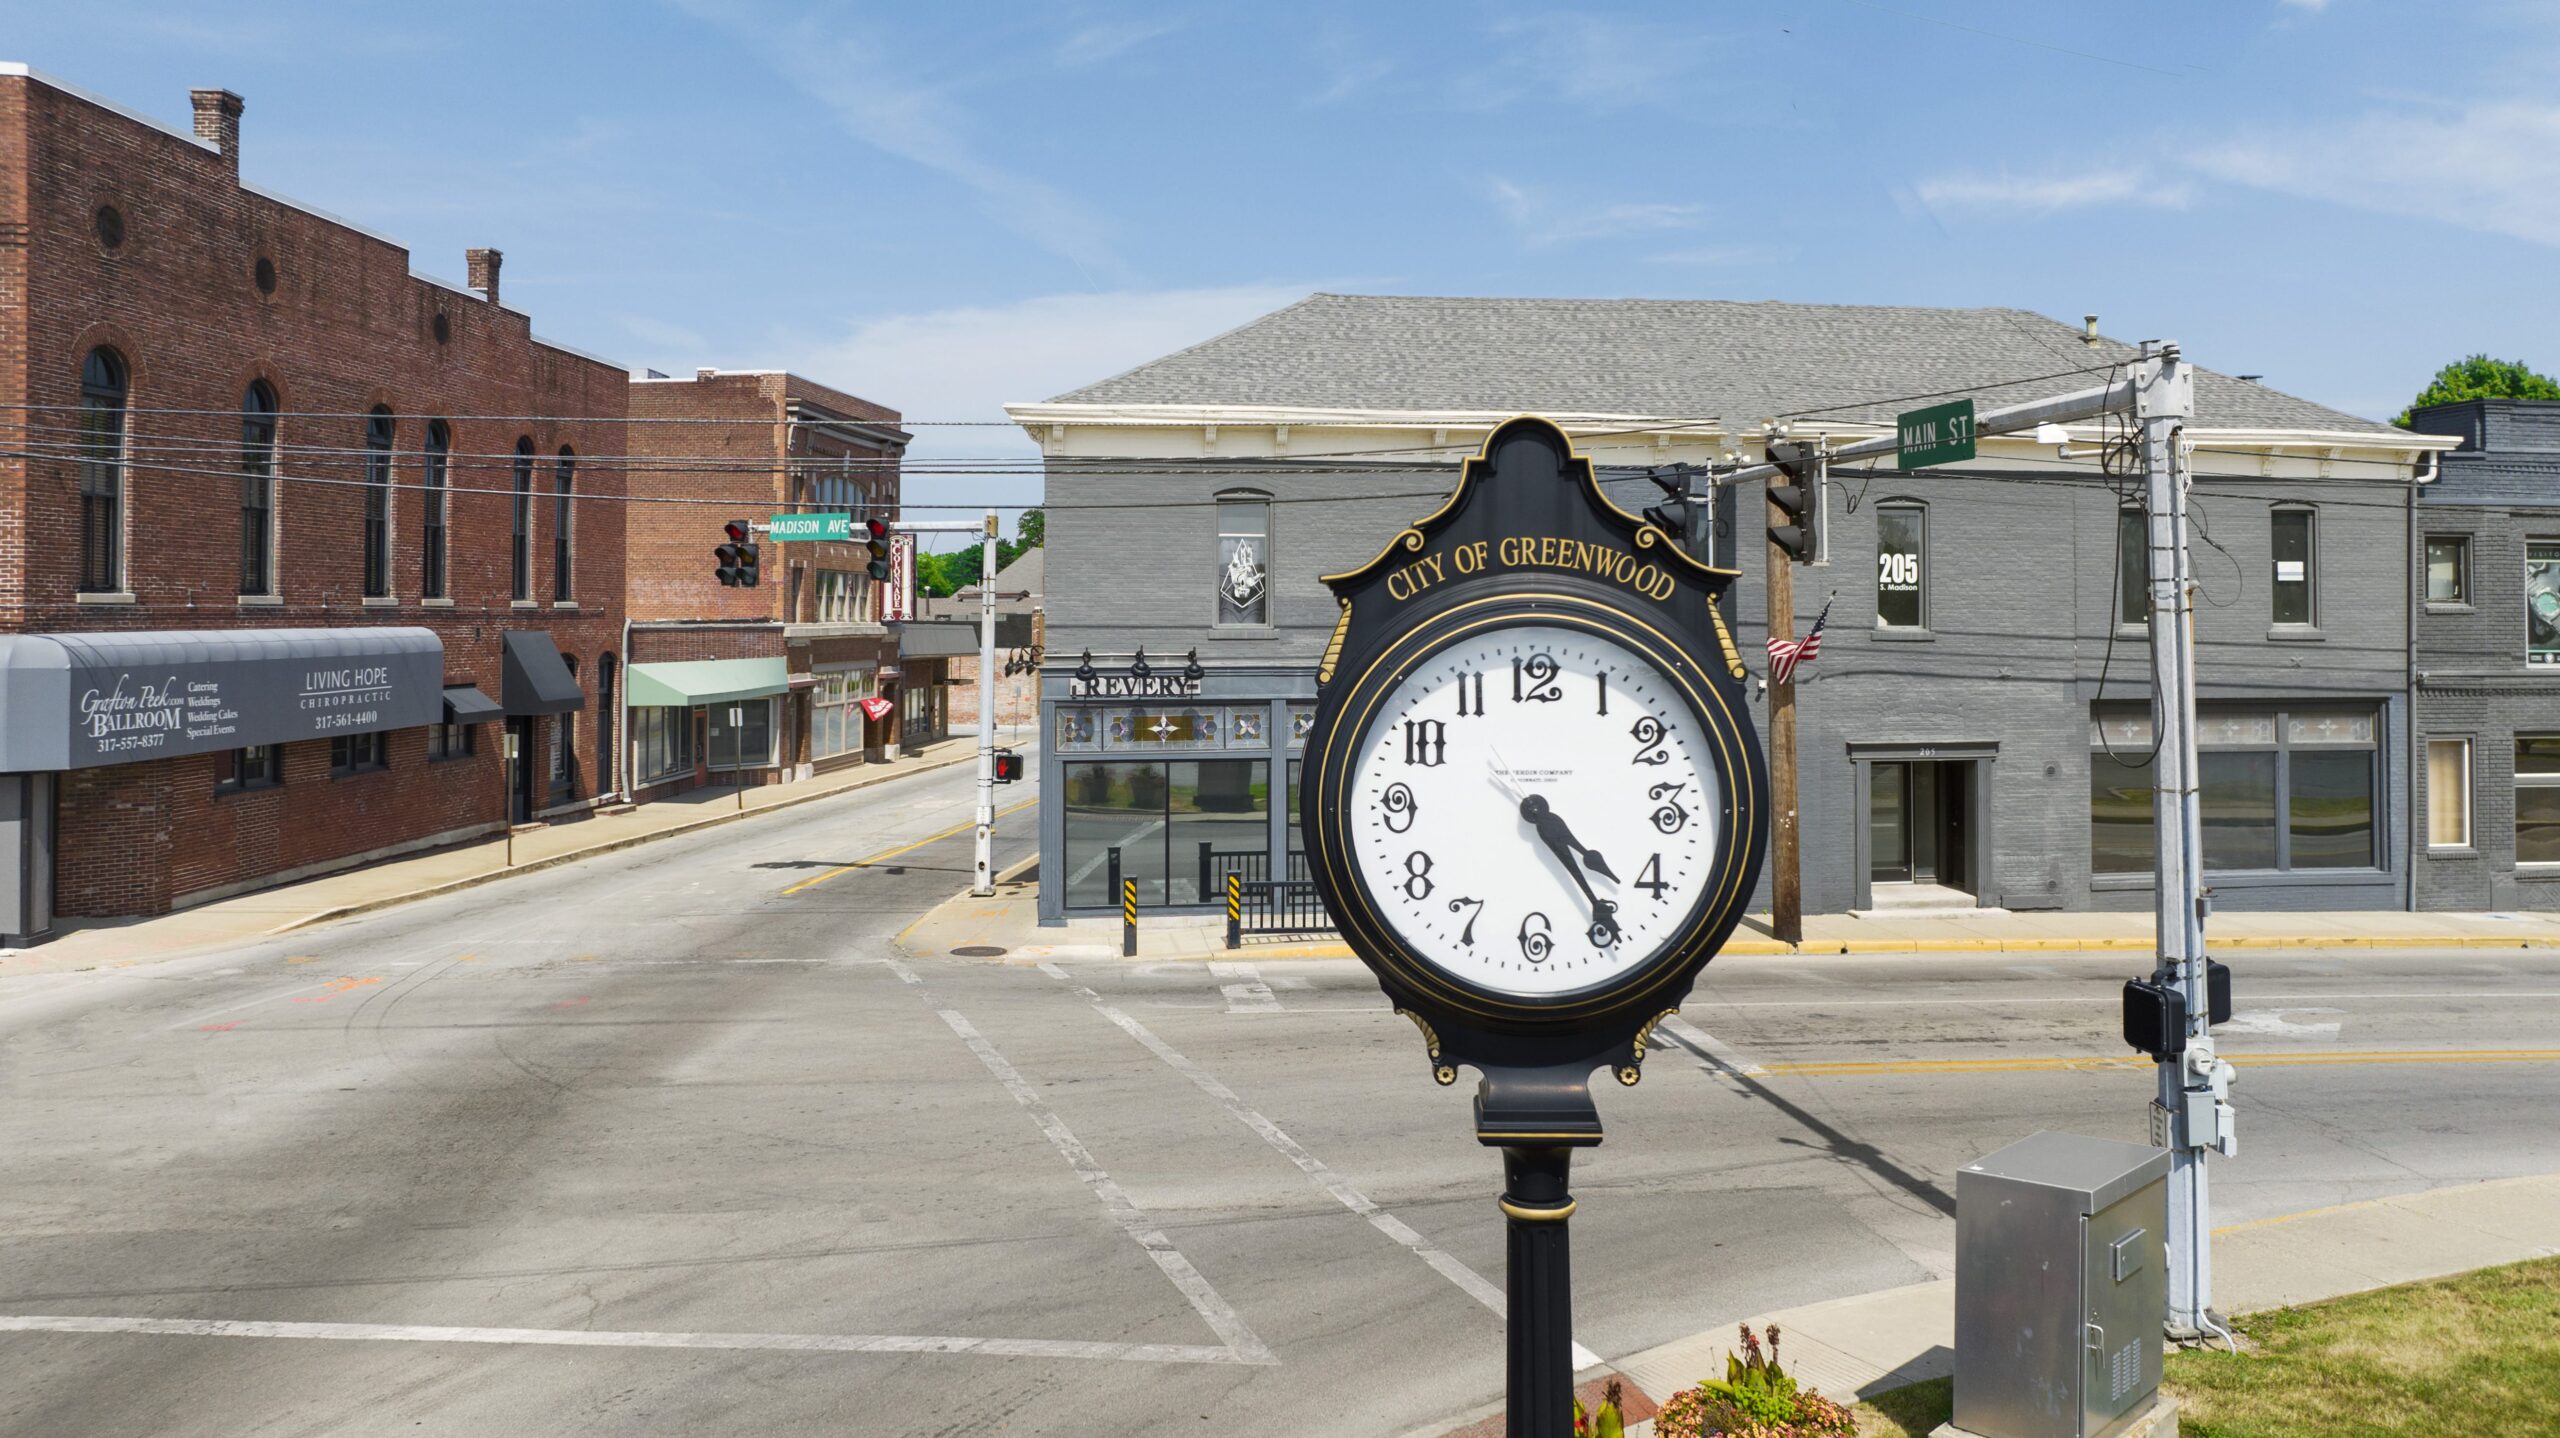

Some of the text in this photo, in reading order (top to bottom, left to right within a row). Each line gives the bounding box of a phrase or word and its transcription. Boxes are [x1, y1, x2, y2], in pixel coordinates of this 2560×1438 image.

[1904, 415, 1968, 454] MAIN ST
[770, 520, 849, 534] MADISON AVE
[892, 546, 901, 608] COLONNADE
[1387, 537, 1675, 601] CITY OF GREENWOOD
[1879, 553, 1918, 584] 205
[187, 681, 218, 693] Catering
[306, 667, 387, 690] LIVING HOPE
[1085, 677, 1187, 697] REVERY
[1456, 671, 1486, 717] 11
[1512, 653, 1563, 704] 12
[1596, 670, 1609, 716] 1
[187, 695, 221, 708] Weddings
[187, 709, 238, 722] Wedding Cakes
[300, 691, 391, 709] CHIROPRACTIC
[315, 710, 378, 729] 317-561-4400
[88, 708, 182, 737] BALLROOM
[98, 733, 164, 752] 317-557-8377
[186, 724, 236, 740] Special Events
[1404, 719, 1447, 767] 10
[1629, 716, 1671, 766] 2
[1380, 782, 1418, 834] 9
[1648, 782, 1690, 835] 3
[1403, 850, 1435, 901] 8
[1634, 852, 1671, 901] 4
[1448, 896, 1484, 947] 7
[1517, 912, 1556, 964] 6
